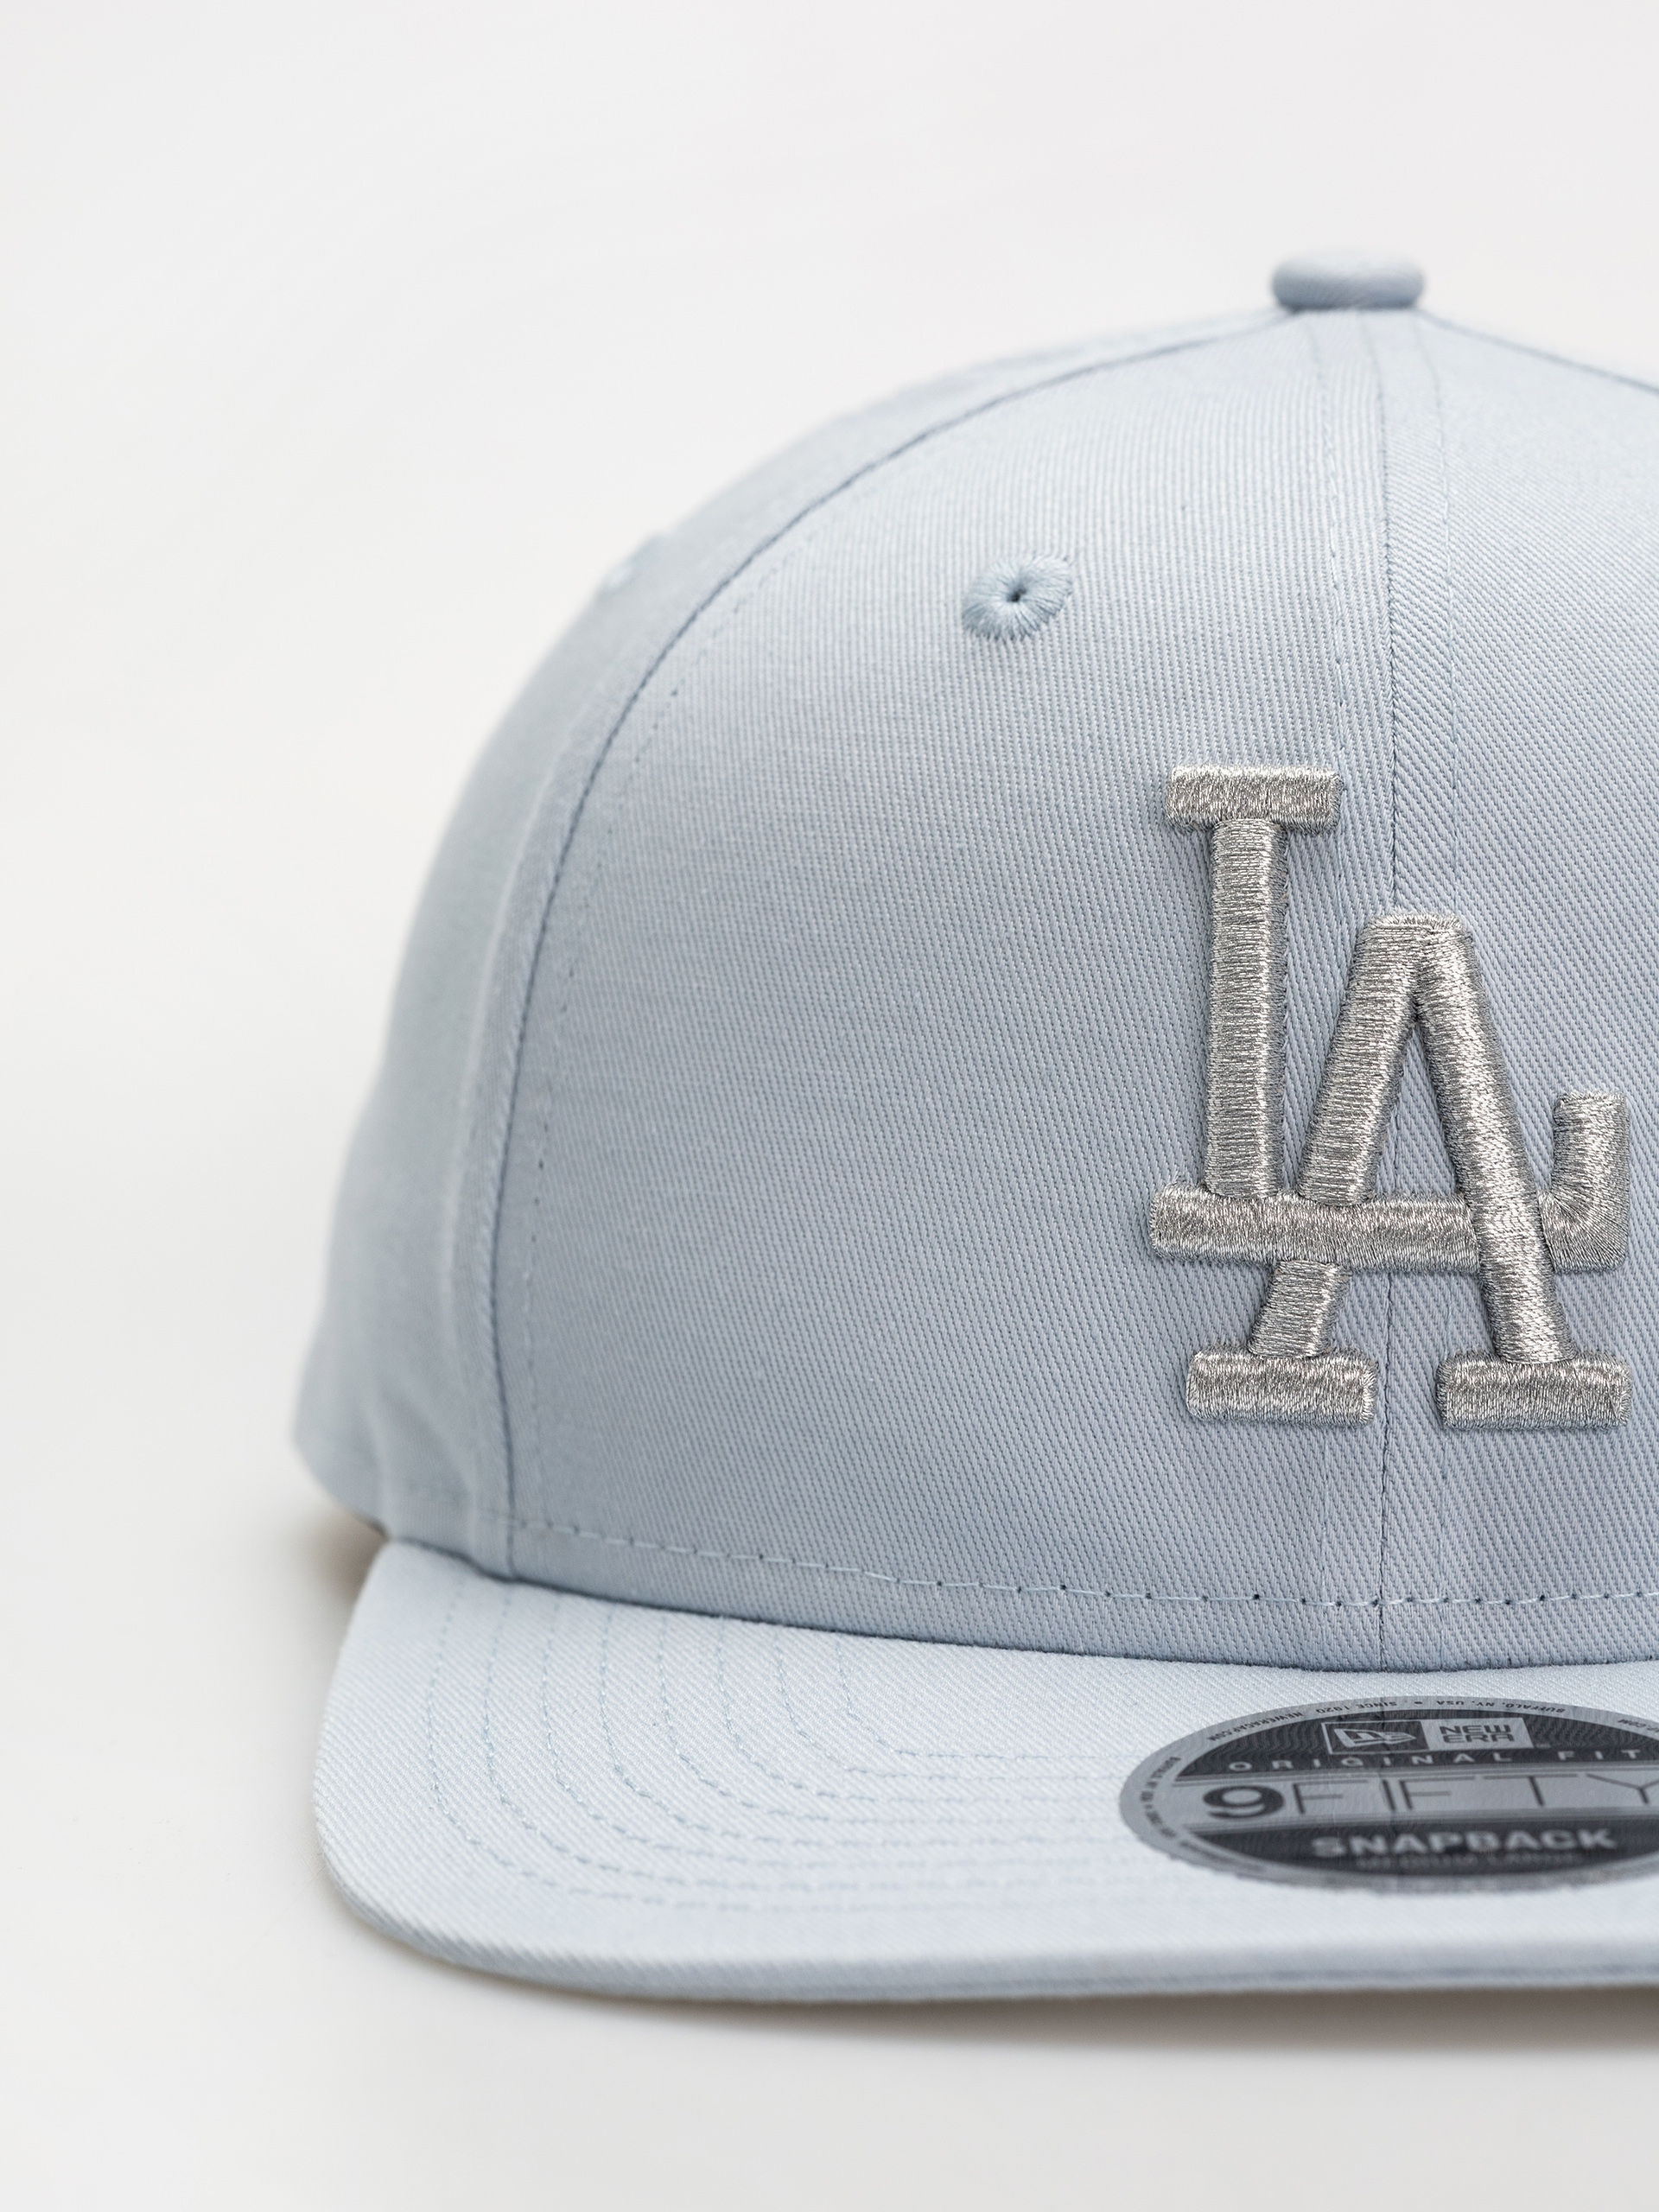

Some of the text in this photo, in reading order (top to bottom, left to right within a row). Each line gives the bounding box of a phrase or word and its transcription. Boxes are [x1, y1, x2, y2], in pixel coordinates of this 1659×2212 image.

[1148, 765, 1631, 1429] LA
[1315, 1705, 1350, 1714] 1920
[1440, 1724, 1511, 1735] NEW
[1442, 1733, 1516, 1744] ERA
[1228, 1749, 1641, 1770] ORIGINAL FIT
[1202, 1772, 1659, 1820] 9FIFTY
[1311, 1828, 1617, 1858] SNAPBACK
